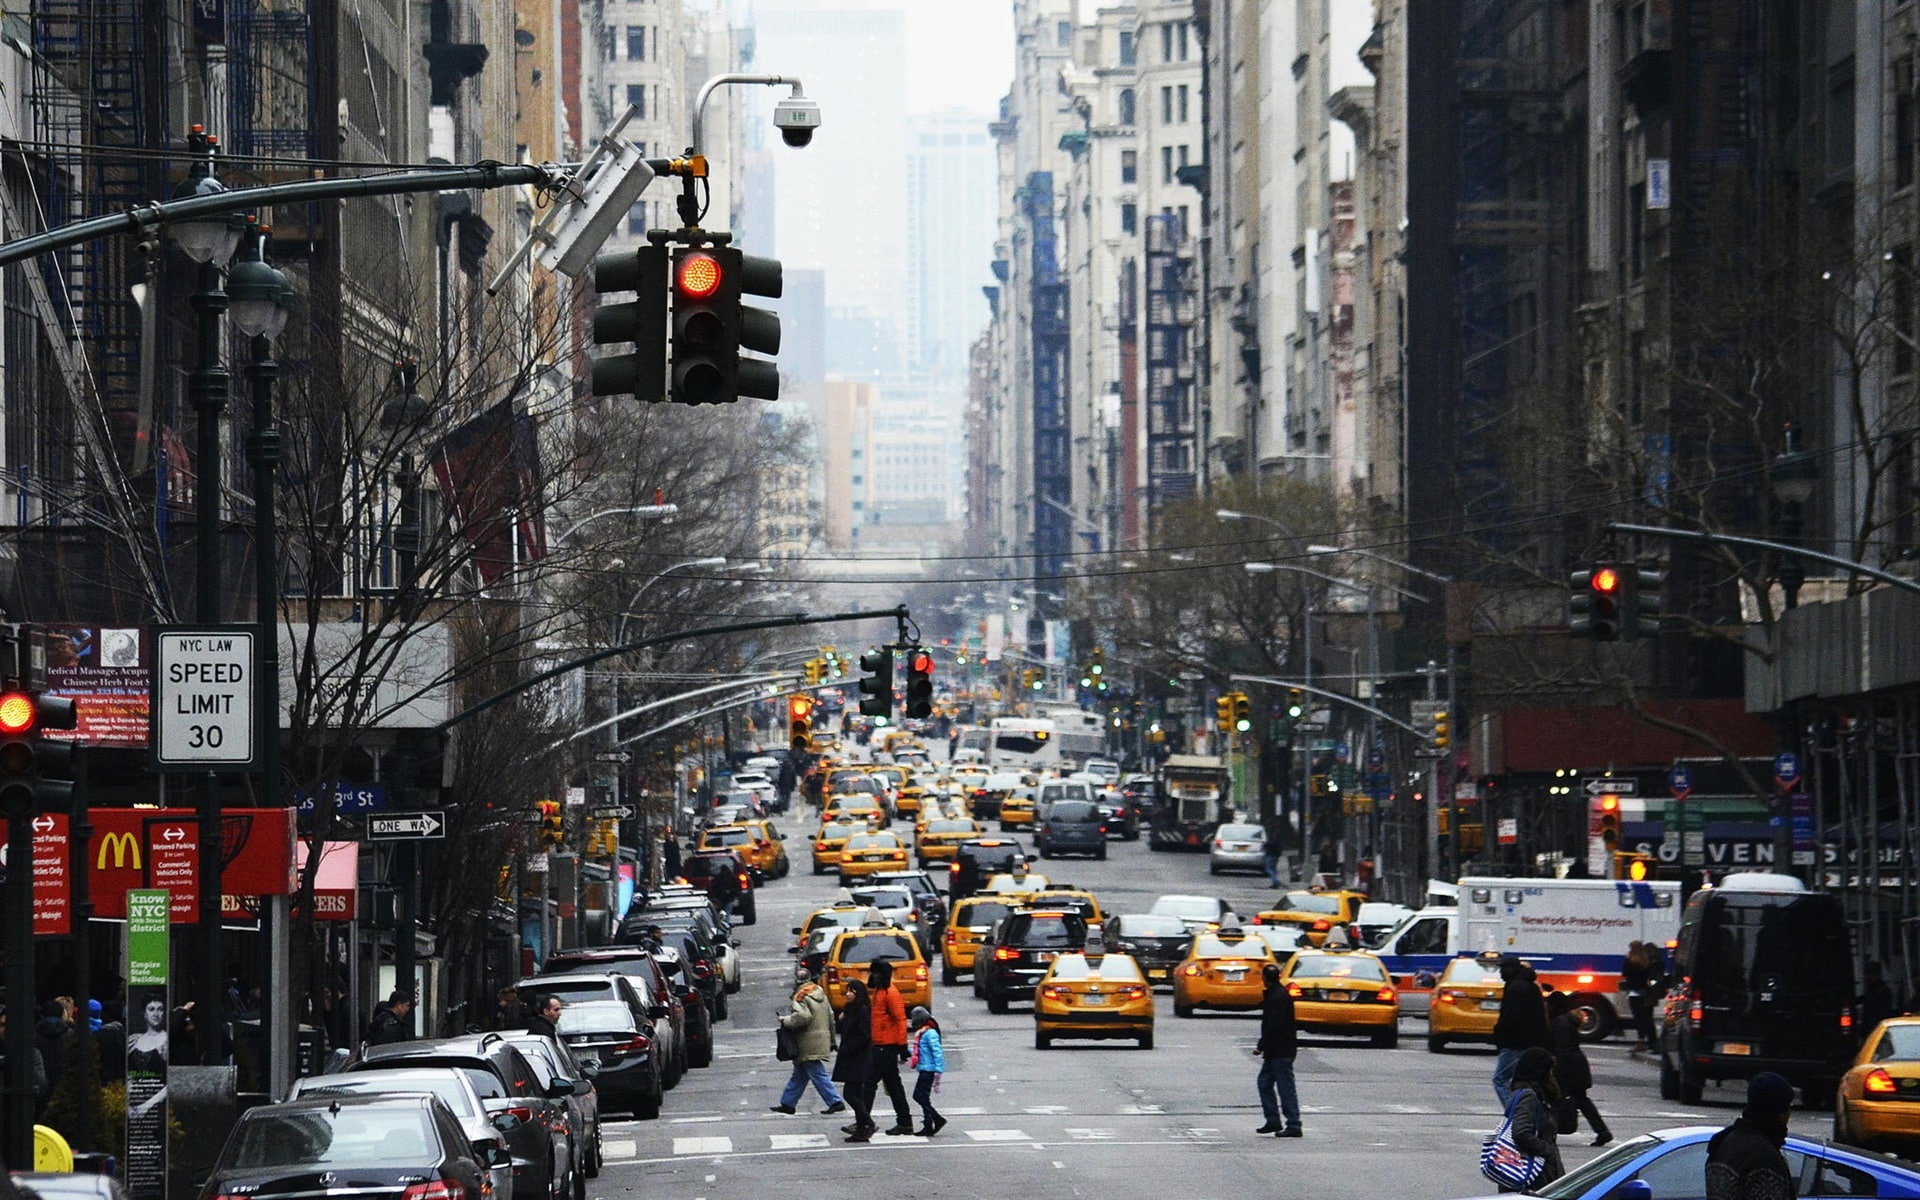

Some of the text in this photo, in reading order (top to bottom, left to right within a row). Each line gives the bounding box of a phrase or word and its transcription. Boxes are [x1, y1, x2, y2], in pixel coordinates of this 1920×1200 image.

[180, 640, 232, 652] NYC LAW
[80, 667, 118, 676] Massage,
[169, 663, 243, 683] SPEED
[63, 678, 98, 686] Chinese
[100, 678, 122, 686] Herb
[124, 678, 143, 686] Foot
[178, 694, 234, 714] LIMIT
[188, 725, 223, 748] 30
[358, 791, 374, 807] St
[379, 820, 432, 832] ONE WAY
[158, 861, 191, 869] Commercial
[179, 869, 193, 877] Only
[130, 894, 166, 904] know
[314, 896, 346, 912] ERS
[131, 905, 166, 917] NYC
[131, 961, 161, 970] Empire
[131, 976, 166, 984] Building
